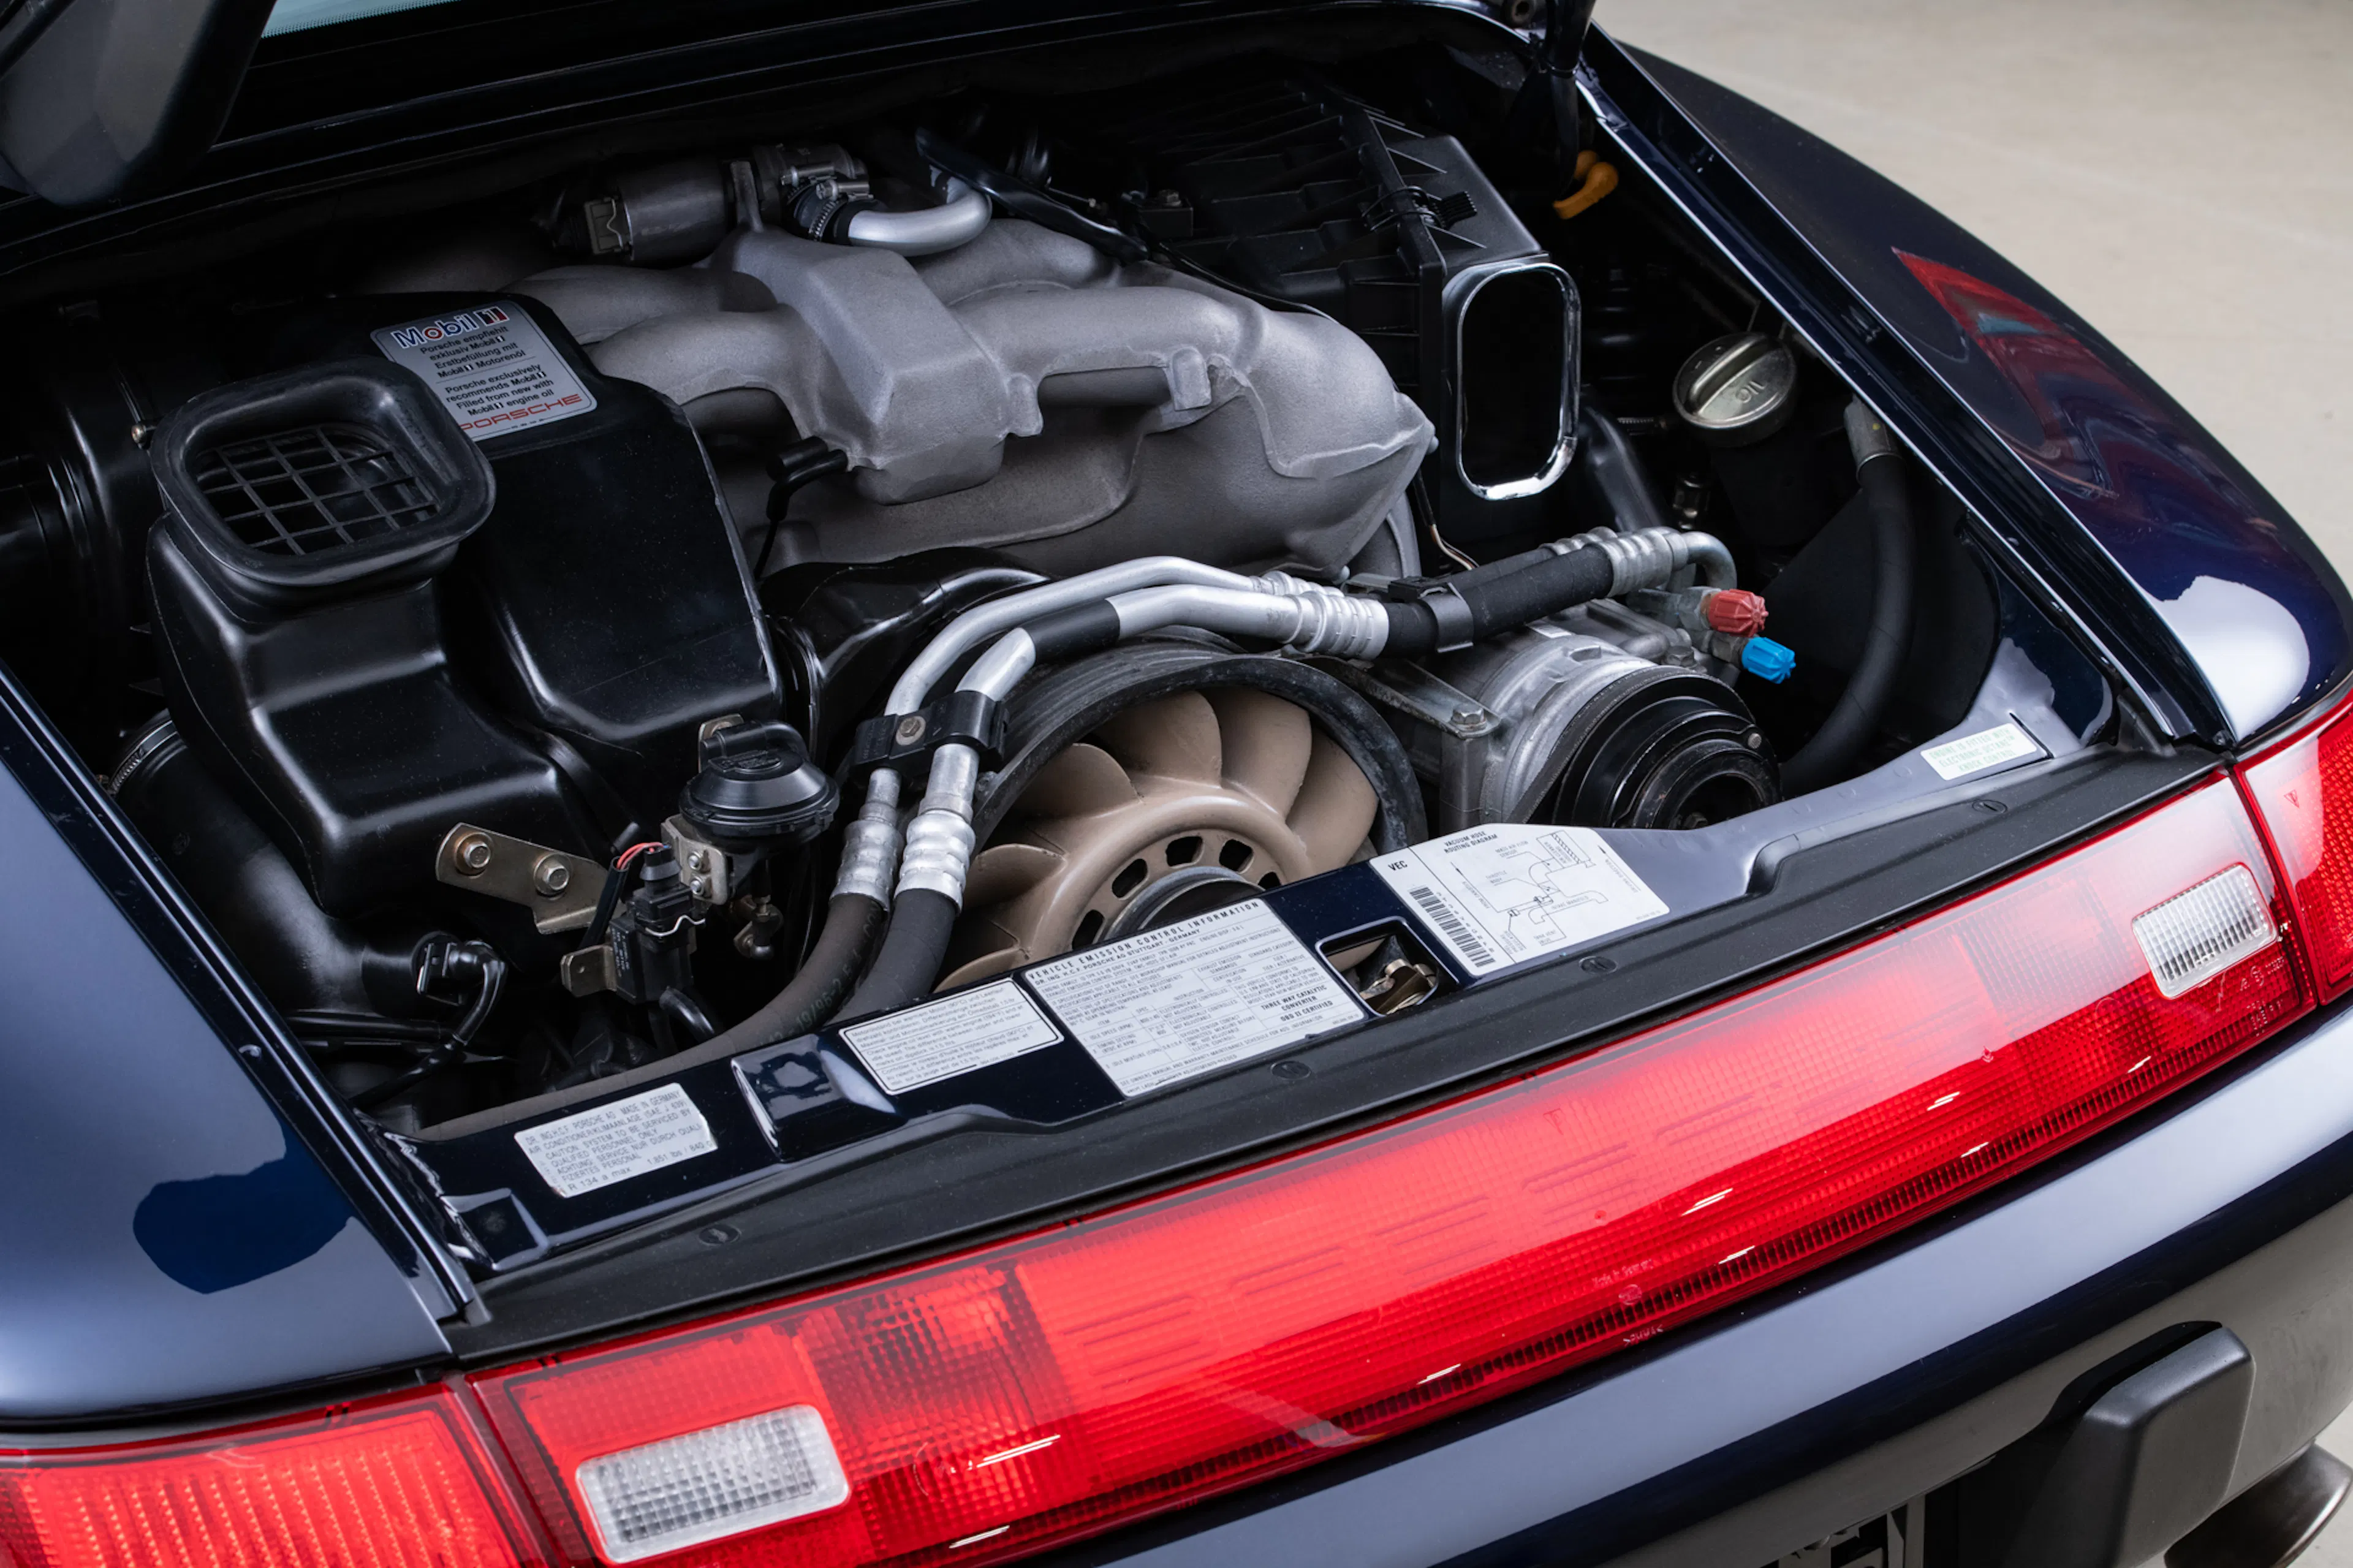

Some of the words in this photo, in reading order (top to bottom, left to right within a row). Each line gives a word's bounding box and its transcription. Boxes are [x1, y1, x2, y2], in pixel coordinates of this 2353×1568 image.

[391, 313, 477, 349] Mobil
[419, 339, 461, 354] Porsche
[463, 326, 509, 343] empfiehlt
[429, 346, 469, 360] exklusiv
[469, 338, 496, 349] Mobil
[434, 347, 501, 369] Erstbefüllung
[502, 342, 518, 351] mit
[437, 366, 464, 377] Mobil
[475, 349, 526, 368] Motorenöl
[444, 379, 487, 394] Porsche
[488, 364, 541, 382] exclusively
[445, 382, 510, 403] recommends
[510, 374, 537, 385] Mobil
[1735, 381, 1768, 404] OIL
[456, 397, 485, 409] Filled
[485, 392, 510, 402] from
[510, 386, 531, 395] new
[532, 379, 554, 389] with
[467, 404, 494, 415] Mobil
[506, 394, 540, 406] engine
[541, 388, 554, 397] oil
[459, 393, 583, 431] PORSCHE
[1444, 836, 1469, 846] VACUUM
[1444, 842, 1471, 853] ROUTING
[1470, 833, 1498, 846] DIAGRAM
[1388, 860, 1408, 871] VEC
[1028, 961, 1074, 979] VEHICLE
[1078, 942, 1131, 964] EMISSION
[1136, 926, 1183, 945] CONTROL
[1188, 901, 1259, 928] INFORMATION
[1083, 956, 1115, 969] PORSCHE
[1127, 941, 1163, 956] STUTTGART
[1169, 929, 1199, 942] GERMANY
[1260, 1000, 1281, 1010] THREE
[1296, 985, 1327, 998] CATALYTIC
[1281, 996, 1317, 1011] CONVERTER
[1302, 1000, 1333, 1014] CERTIFIED
[572, 1114, 605, 1129] PORSCHE
[620, 1103, 640, 1115] MADE
[650, 1091, 679, 1106] GERMANY
[582, 1133, 613, 1148] SYSTEM
[628, 1124, 640, 1134] BE
[642, 1112, 679, 1129] SERVICED
[680, 1108, 691, 1117] BY
[528, 1145, 541, 1154] AIR
[551, 1150, 589, 1168] QUALIFIED
[591, 1136, 636, 1154] PERSONNEL
[638, 1128, 657, 1139] ONLY
[596, 1146, 630, 1162] SERVICE
[630, 1140, 648, 1151] NUR
[649, 1132, 676, 1145] DURCH
[561, 1165, 600, 1181] FIZIERTES
[601, 1153, 642, 1168] PERSONAL
[580, 1176, 599, 1186] 134
[611, 1167, 632, 1176] max
[689, 1142, 705, 1151] 840
